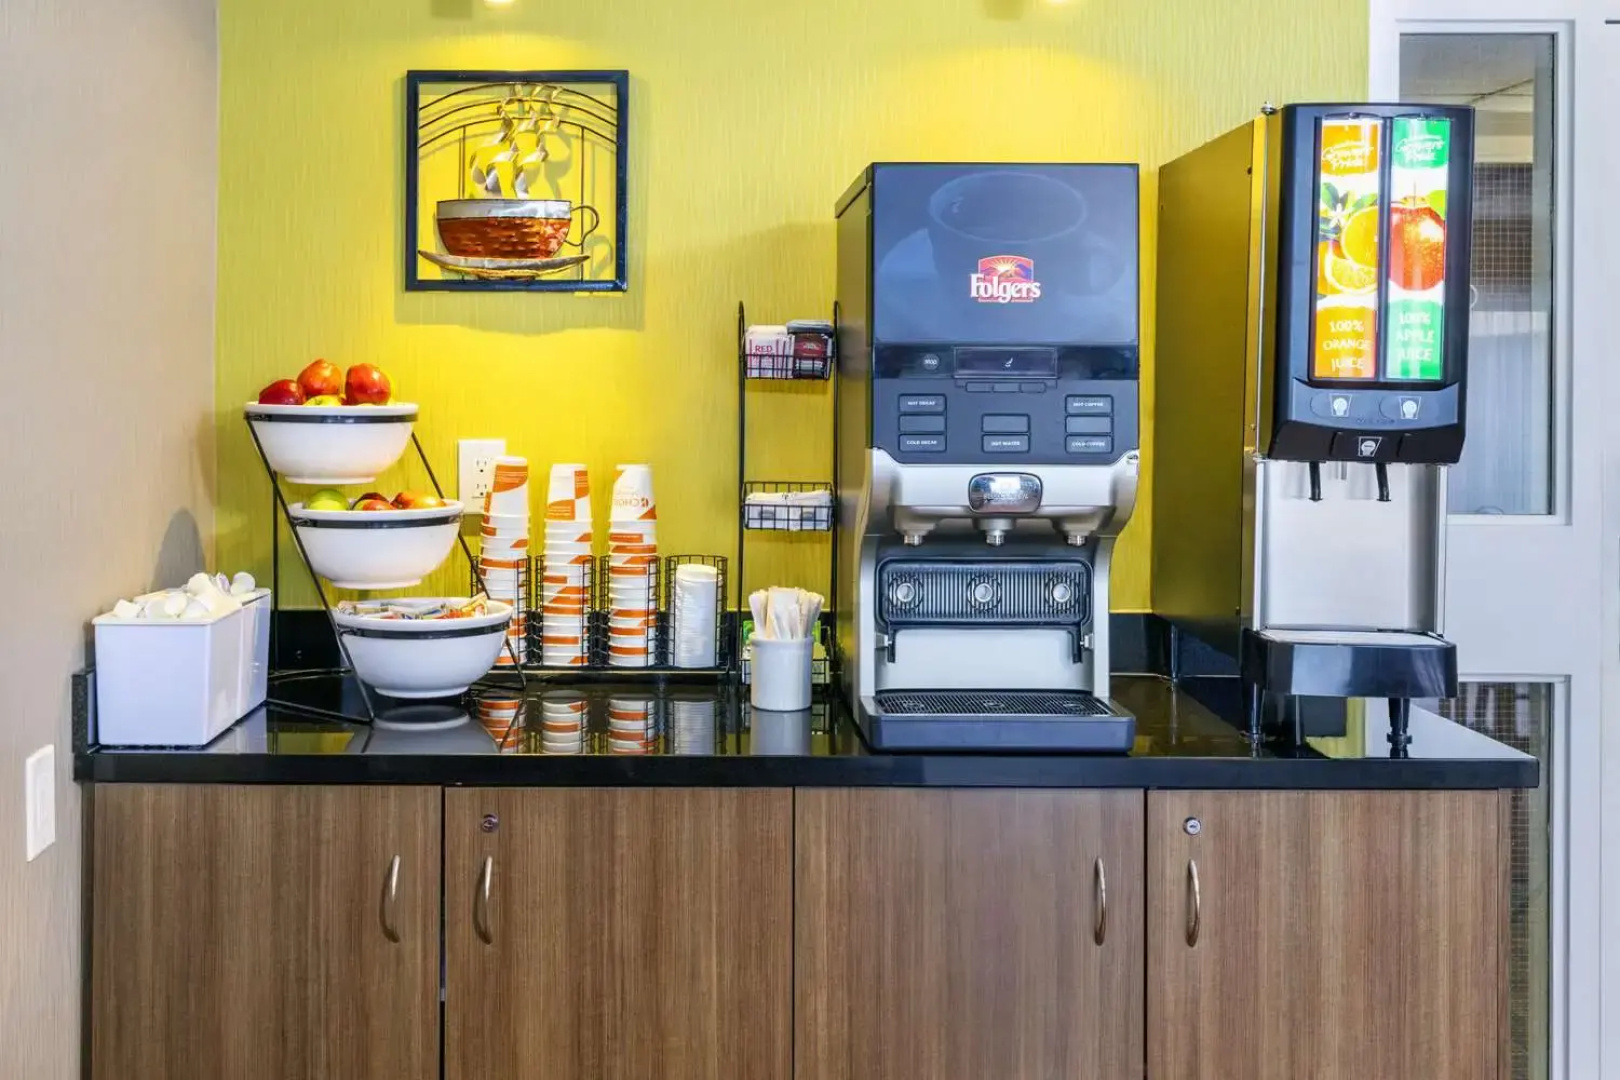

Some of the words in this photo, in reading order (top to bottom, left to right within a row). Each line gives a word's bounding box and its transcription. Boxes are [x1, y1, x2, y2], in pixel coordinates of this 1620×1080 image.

[970, 273, 1041, 303] Folgers
[1400, 312, 1431, 325] 100%
[1329, 320, 1364, 333] 100%
[1396, 329, 1435, 344] APPLE
[755, 345, 772, 353] RED
[1322, 338, 1371, 351] ORANGE
[1399, 348, 1433, 364] JUICE
[1331, 358, 1365, 372] JUICE
